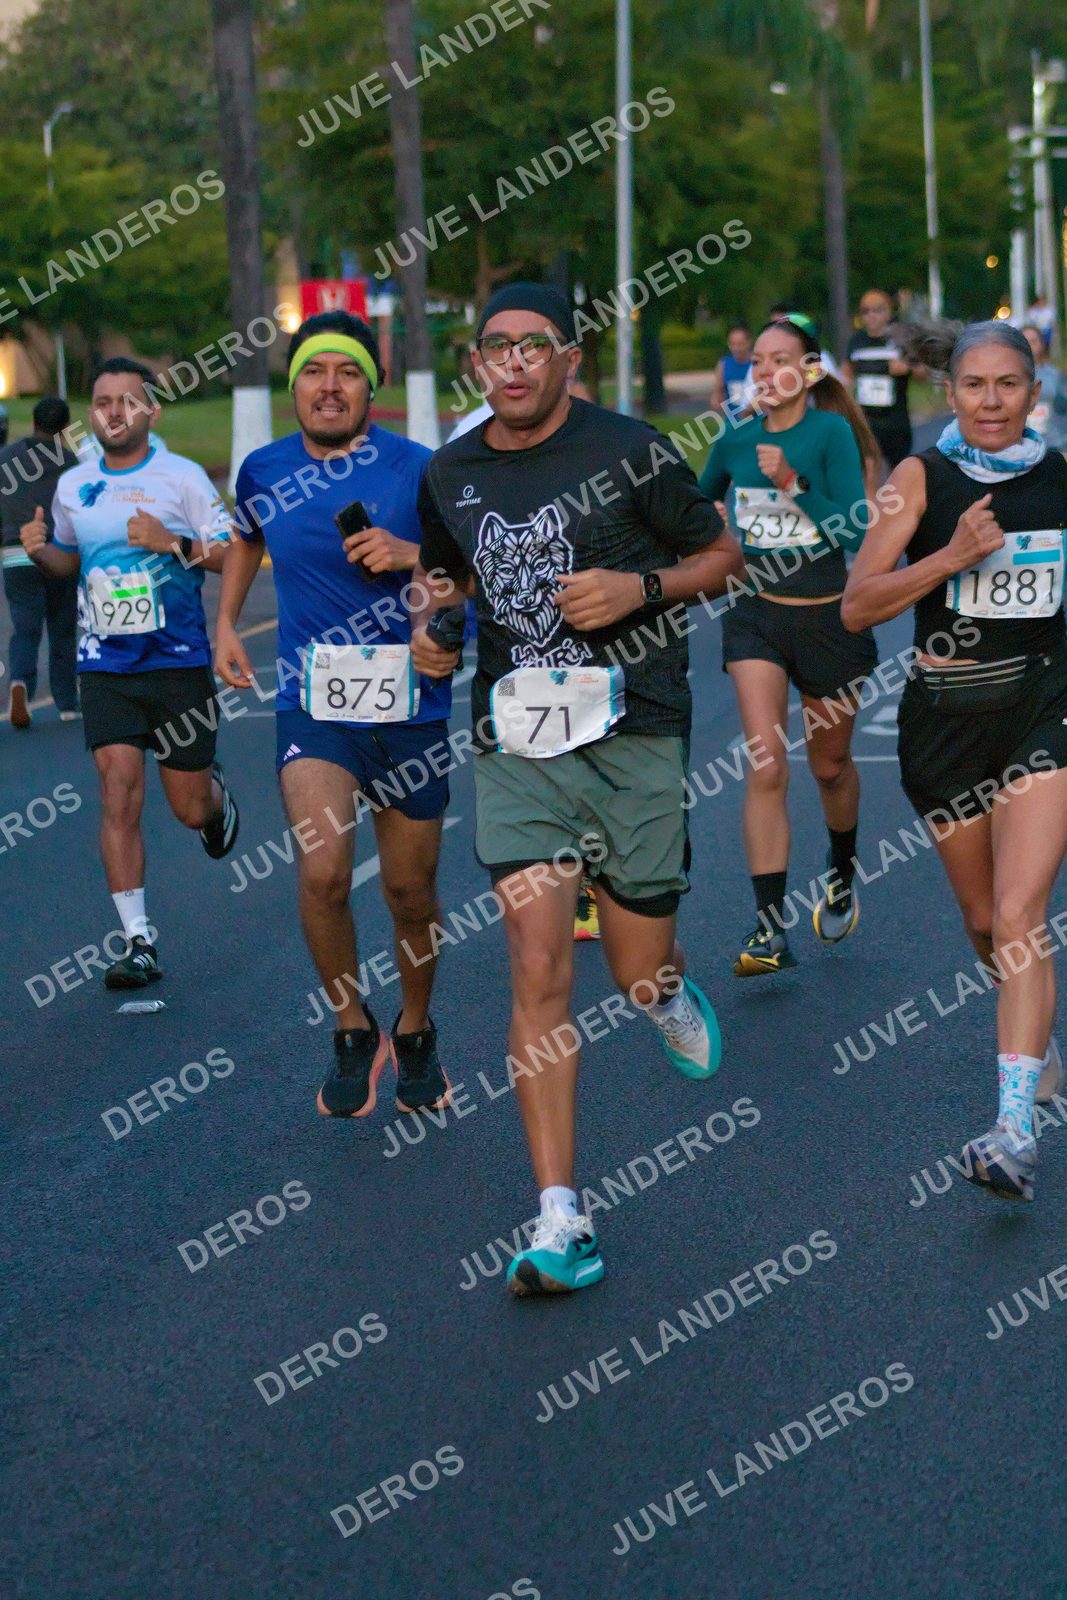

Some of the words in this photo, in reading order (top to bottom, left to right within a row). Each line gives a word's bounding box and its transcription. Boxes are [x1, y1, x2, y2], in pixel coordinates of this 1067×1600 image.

[455, 497, 482, 509] TOPTIME
[748, 511, 802, 539] 632
[969, 568, 1055, 606] 1881
[90, 598, 152, 626] 1929
[327, 677, 396, 712] 875
[525, 706, 571, 745] 71
